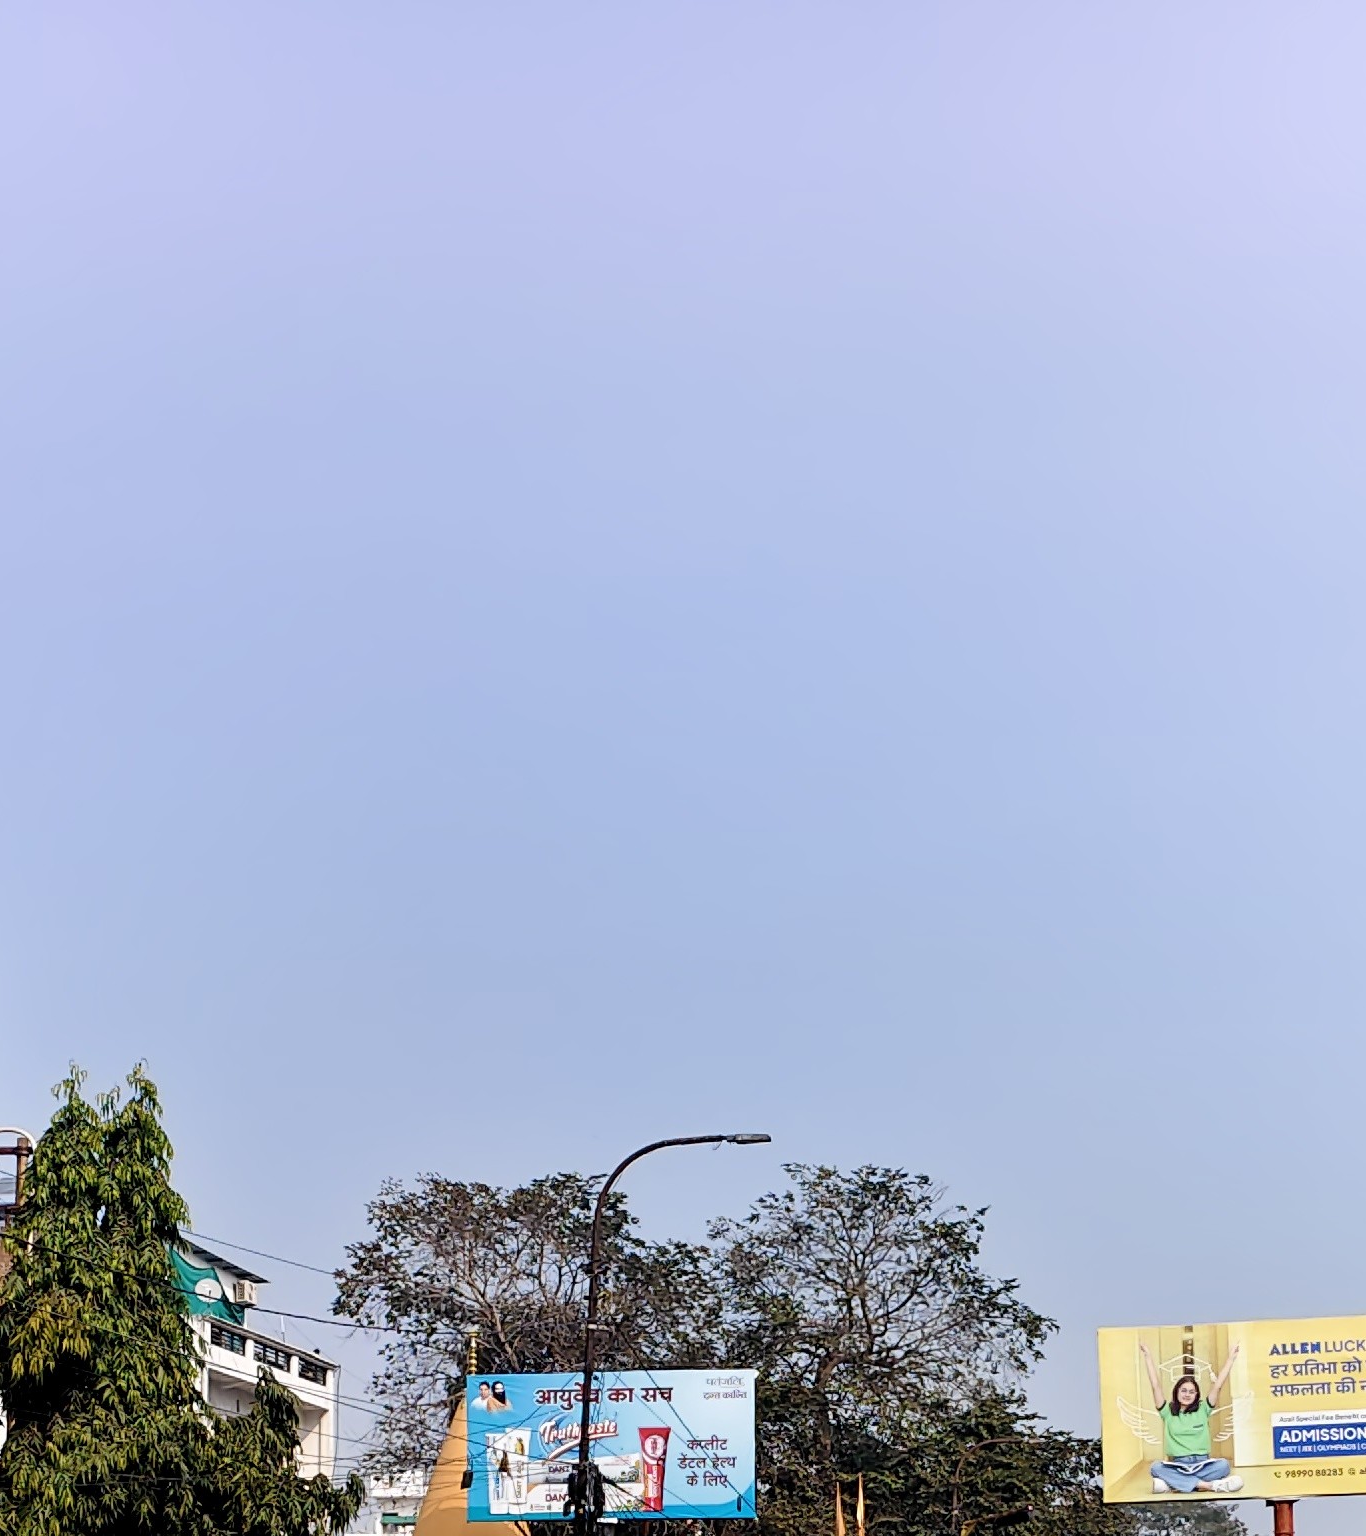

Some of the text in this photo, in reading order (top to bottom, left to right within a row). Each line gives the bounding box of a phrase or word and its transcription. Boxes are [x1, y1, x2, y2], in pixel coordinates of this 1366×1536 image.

[1269, 1341, 1321, 1356] ALLEN
[1269, 1363, 1289, 1379] हर
[1293, 1358, 1337, 1377] प्रतिभा
[1341, 1356, 1362, 1374] को
[607, 1386, 634, 1404] का
[640, 1386, 674, 1403] सच
[1270, 1381, 1331, 1398] सफलता
[1335, 1376, 1355, 1394] की
[539, 1418, 619, 1445] Truthaste
[677, 1452, 737, 1469] डेंटल हेल्थ
[686, 1471, 728, 1488] के लिए
